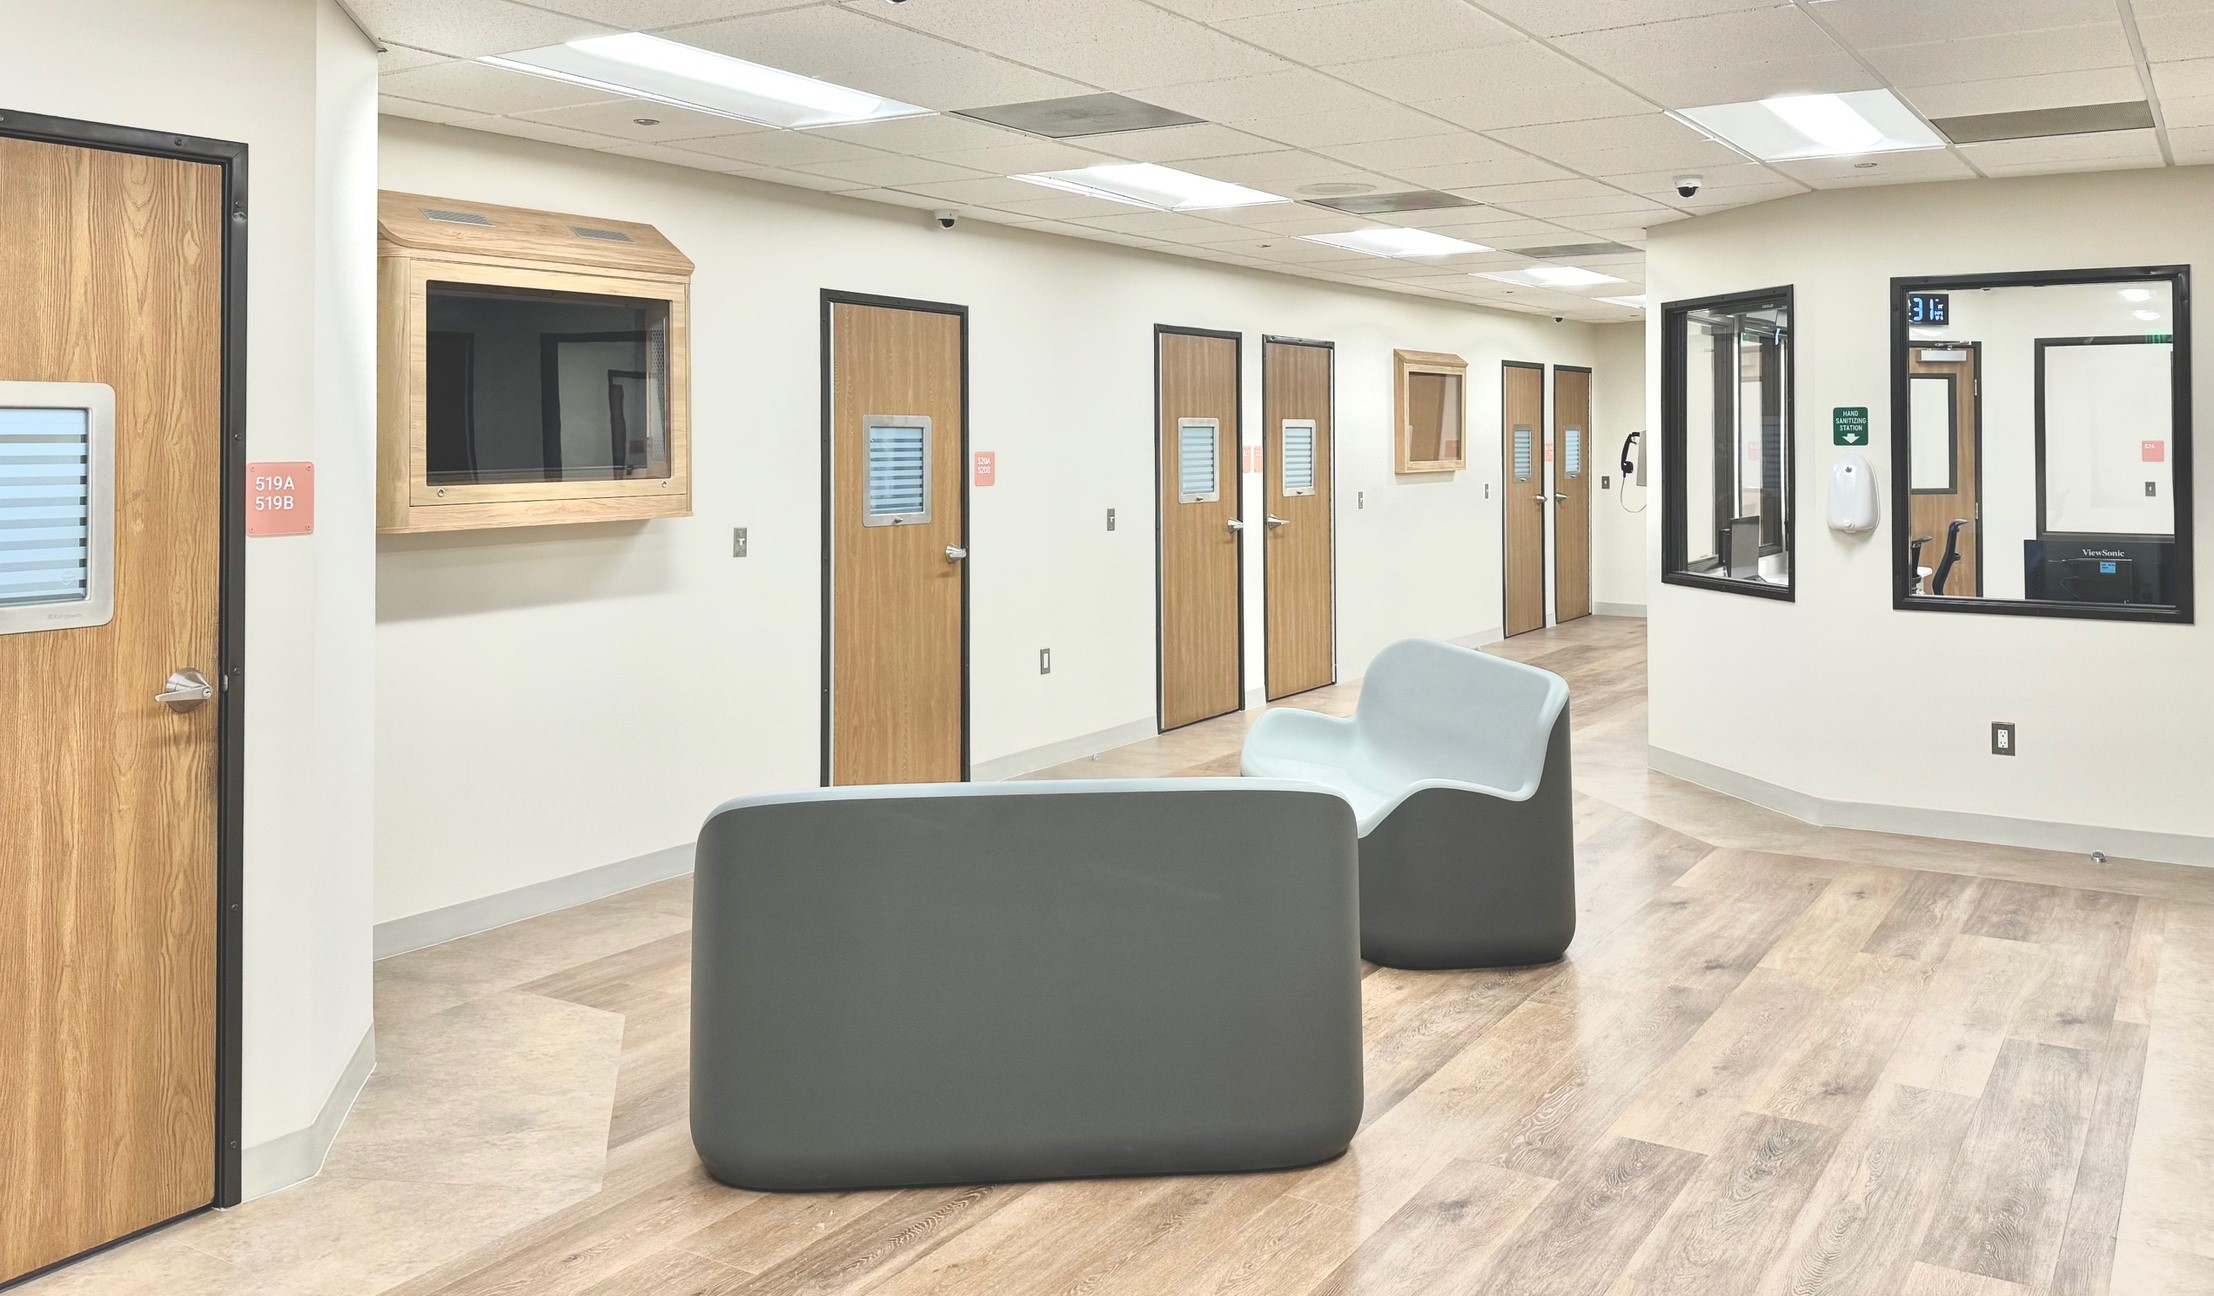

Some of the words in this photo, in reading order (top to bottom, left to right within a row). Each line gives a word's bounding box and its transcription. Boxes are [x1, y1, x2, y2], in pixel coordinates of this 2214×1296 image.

[1835, 417, 1867, 425] SANITIZING
[1839, 424, 1863, 432] STATION
[255, 475, 296, 492] 519A
[255, 495, 295, 511] 519B
[2082, 548, 2125, 557] ViewSonic
